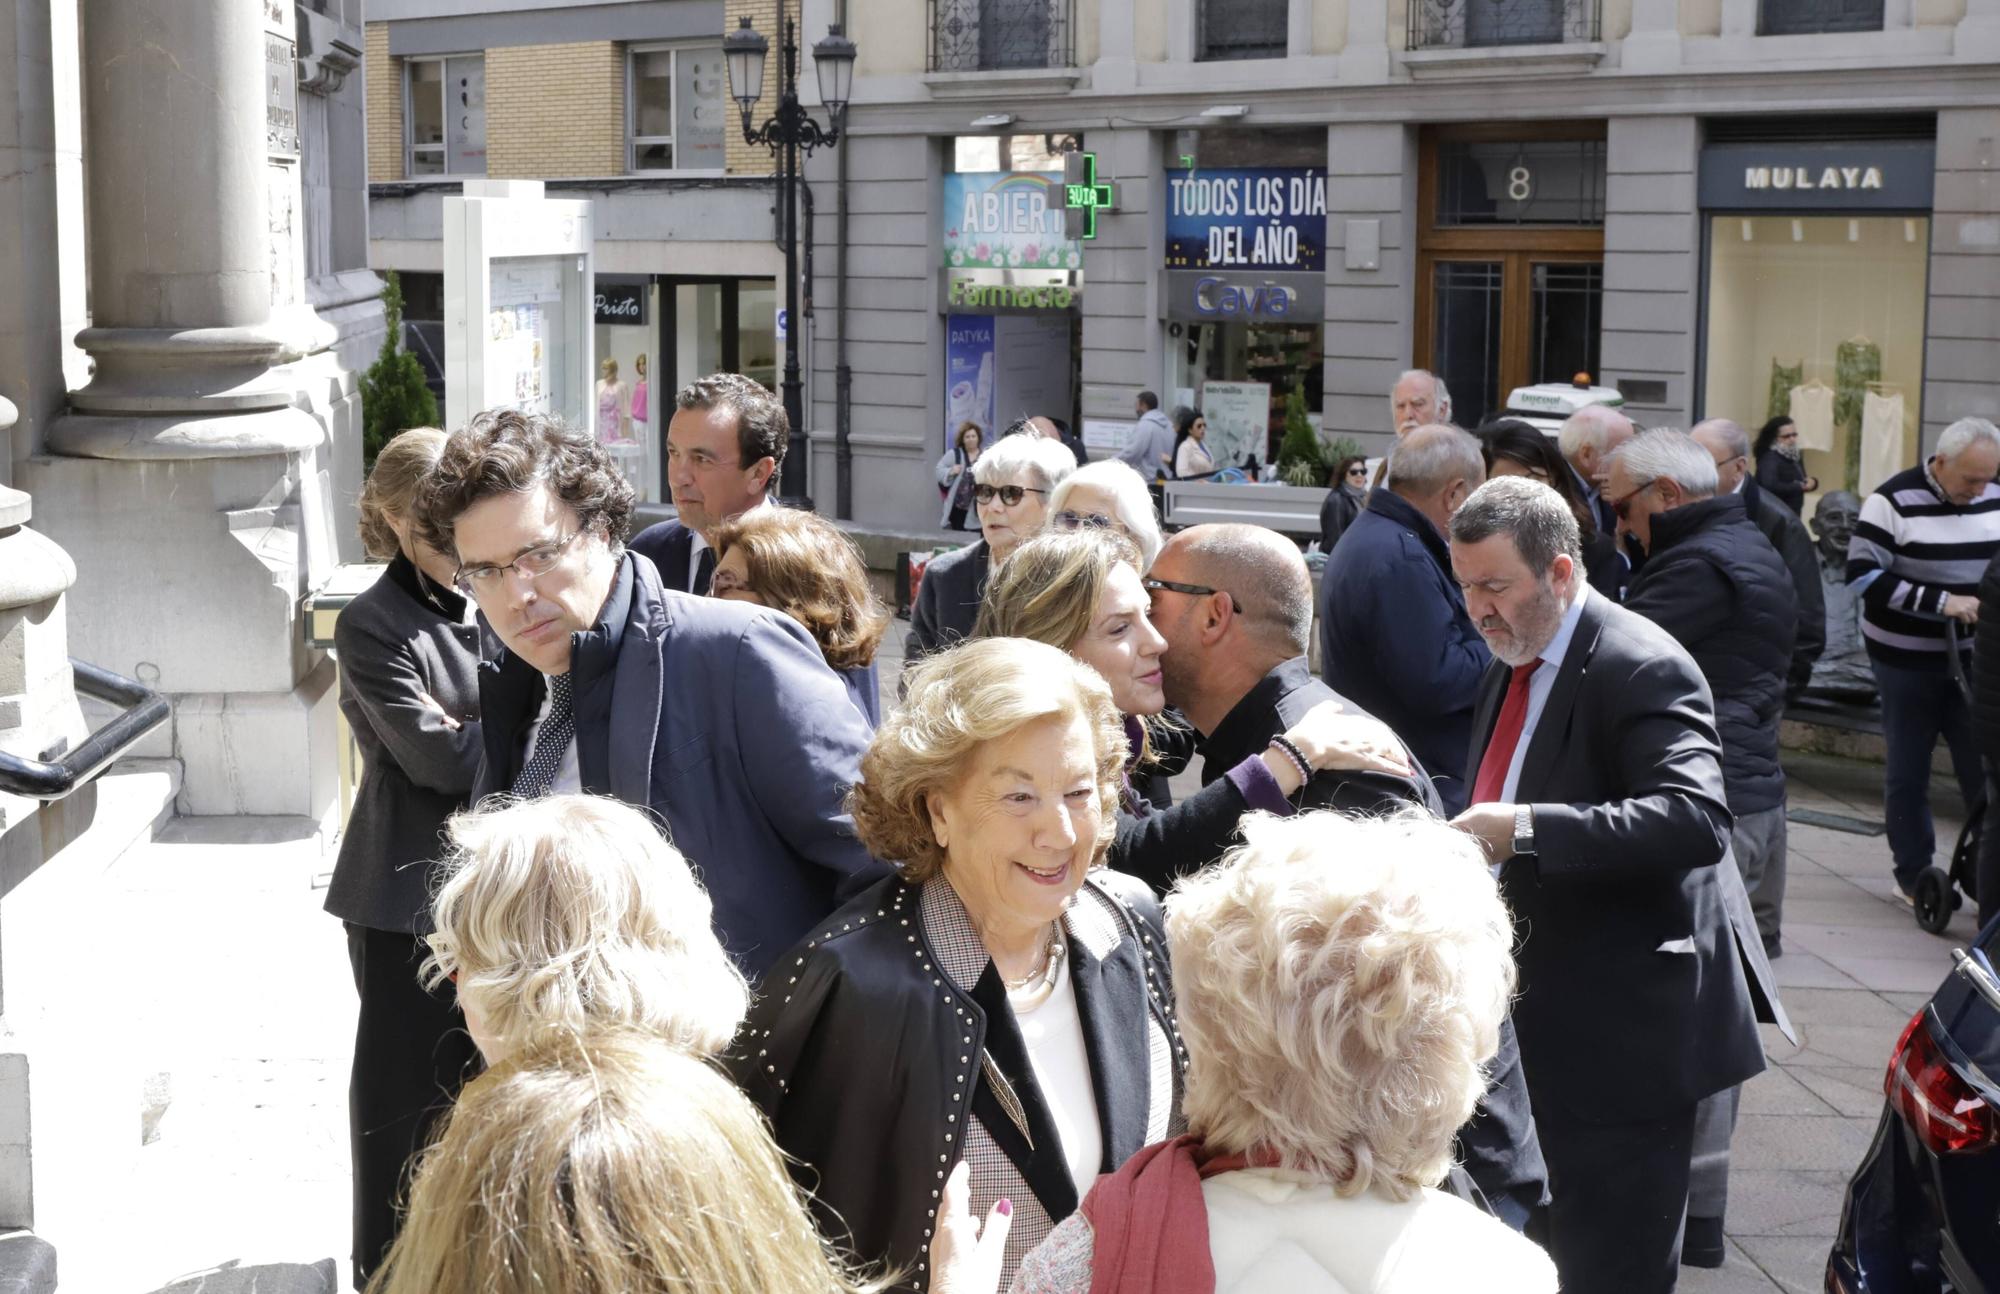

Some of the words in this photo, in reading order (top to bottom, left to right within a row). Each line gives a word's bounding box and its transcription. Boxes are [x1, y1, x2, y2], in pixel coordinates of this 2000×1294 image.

[1509, 166, 1530, 200] 8
[1745, 167, 1882, 188] MULAYA
[1245, 177, 1284, 216] LOS
[1209, 226, 1248, 264] DEL
[1253, 219, 1297, 264] AÑO
[594, 294, 639, 316] Prieto
[951, 277, 1072, 308] Farmacia
[1194, 277, 1290, 314] Cavia
[952, 330, 991, 344] PATYKA
